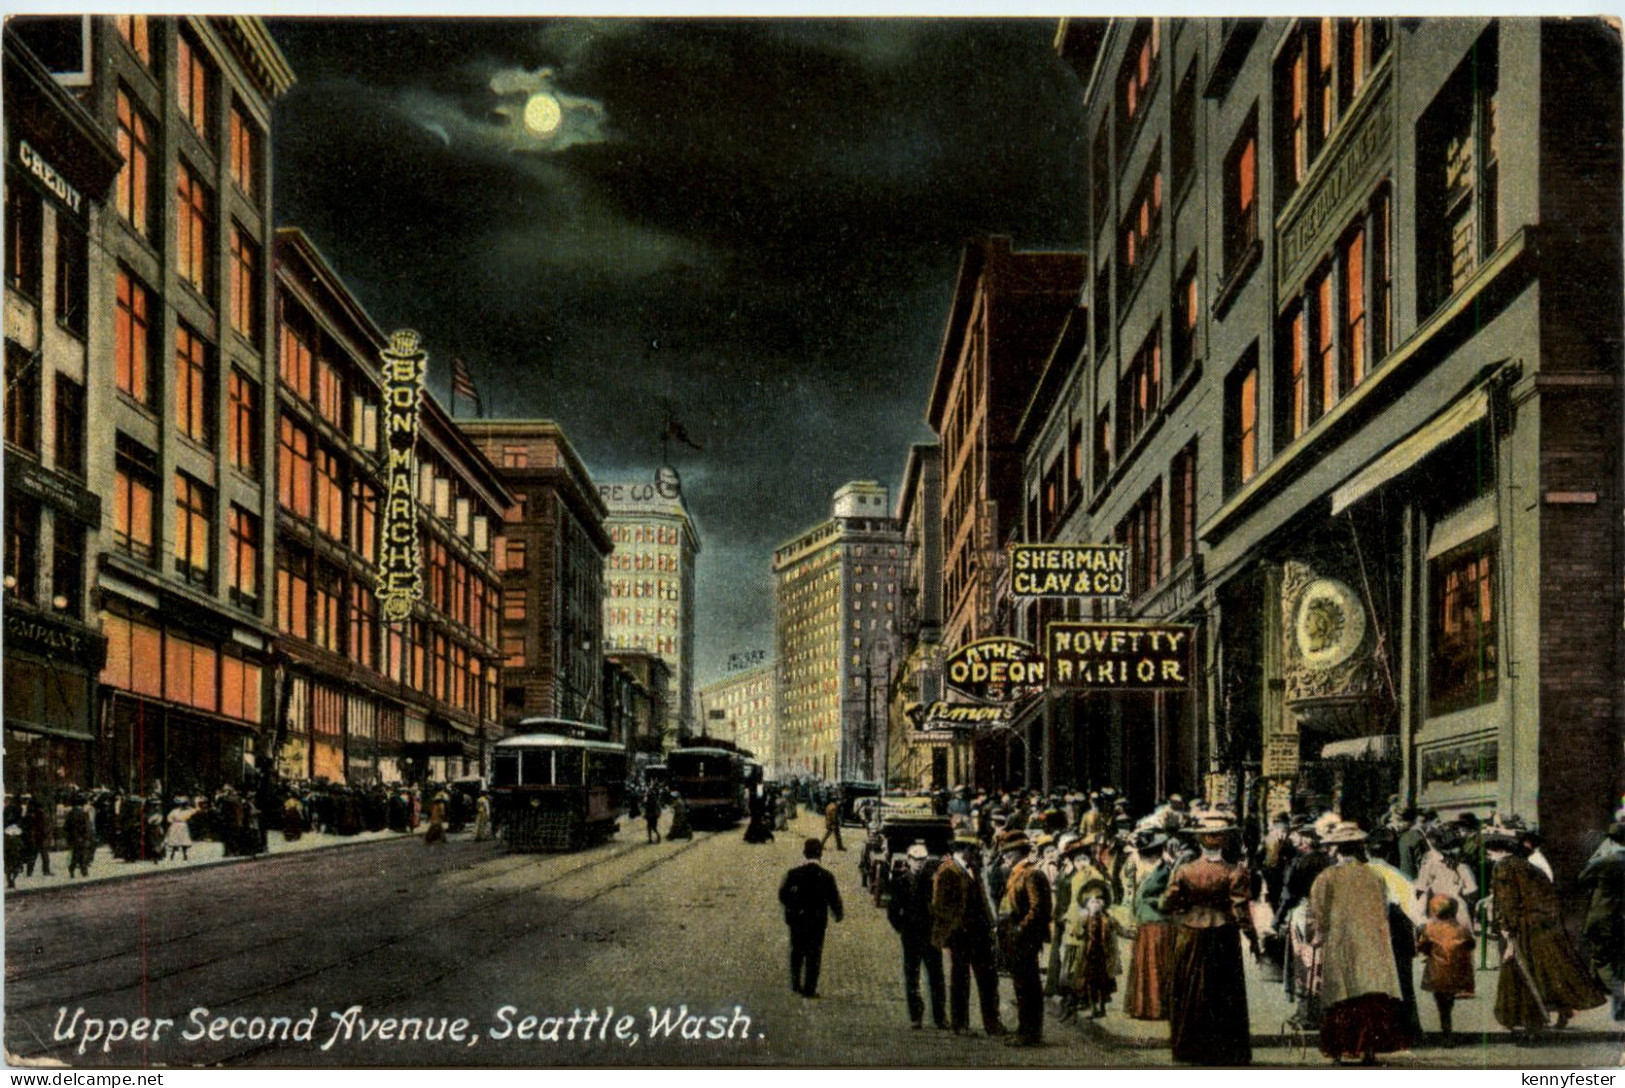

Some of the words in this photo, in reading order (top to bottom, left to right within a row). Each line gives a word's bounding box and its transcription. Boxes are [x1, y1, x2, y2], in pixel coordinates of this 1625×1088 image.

[20, 140, 81, 214] CREDIT
[392, 359, 415, 432] BON
[630, 483, 654, 502] CO
[387, 448, 413, 591] MARCHE
[1015, 550, 1124, 571] SHERMAN
[1014, 572, 1072, 592] CLAY
[1093, 572, 1123, 592] CO
[950, 661, 1045, 683] ODEON
